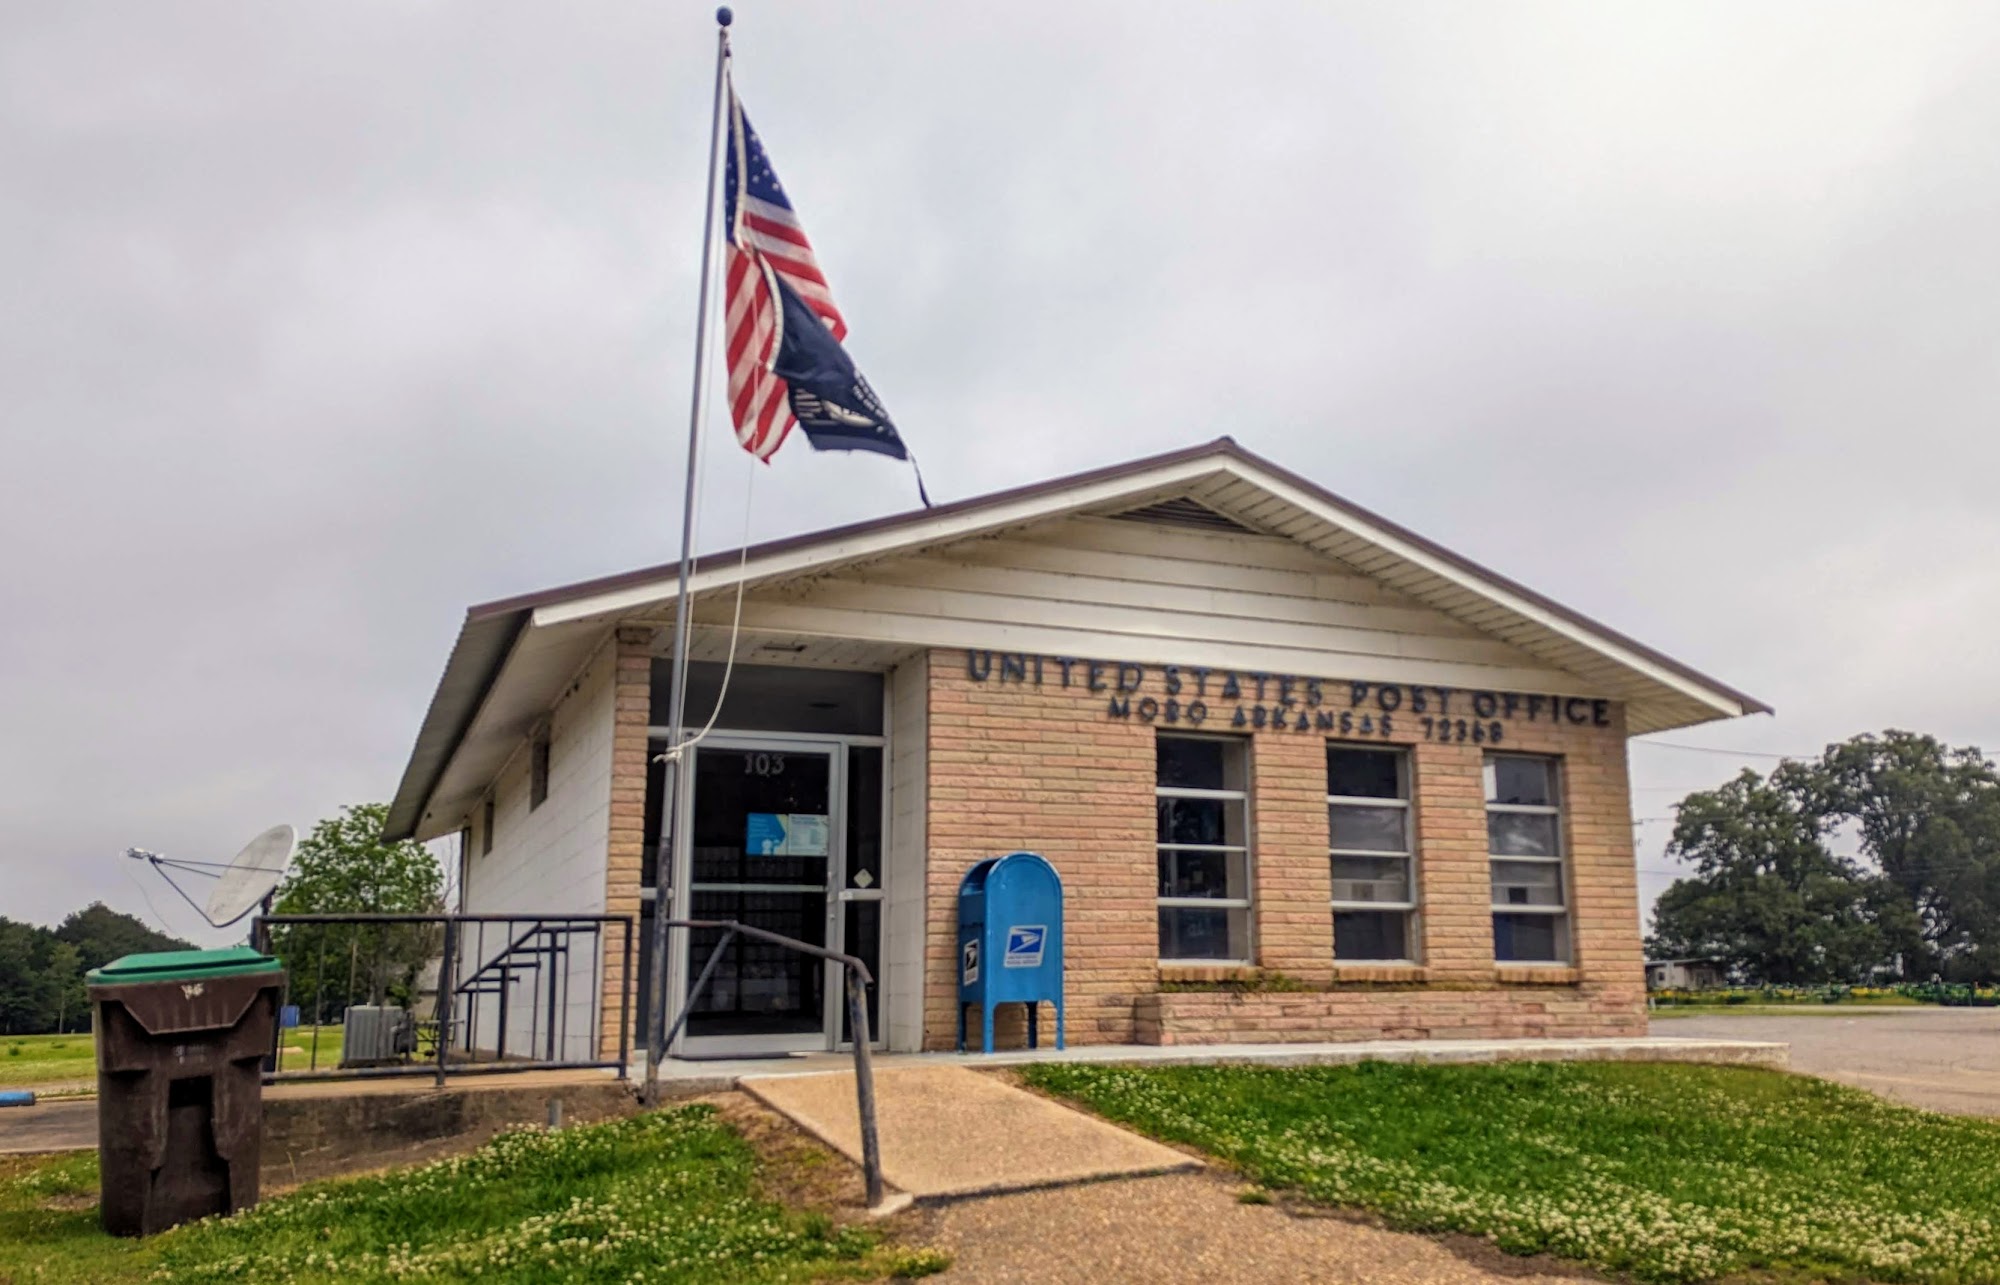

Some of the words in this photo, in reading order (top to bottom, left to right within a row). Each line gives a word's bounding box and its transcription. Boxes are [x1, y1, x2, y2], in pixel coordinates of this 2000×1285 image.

[967, 649, 1143, 694] UNITED
[1164, 664, 1323, 708] STATES
[1349, 680, 1454, 716] POST
[1473, 690, 1611, 728] OFFICE
[1107, 695, 1208, 724] MORO
[1229, 704, 1394, 737] ARKANSAS
[1419, 716, 1505, 744] 72368
[744, 753, 786, 778] 103
